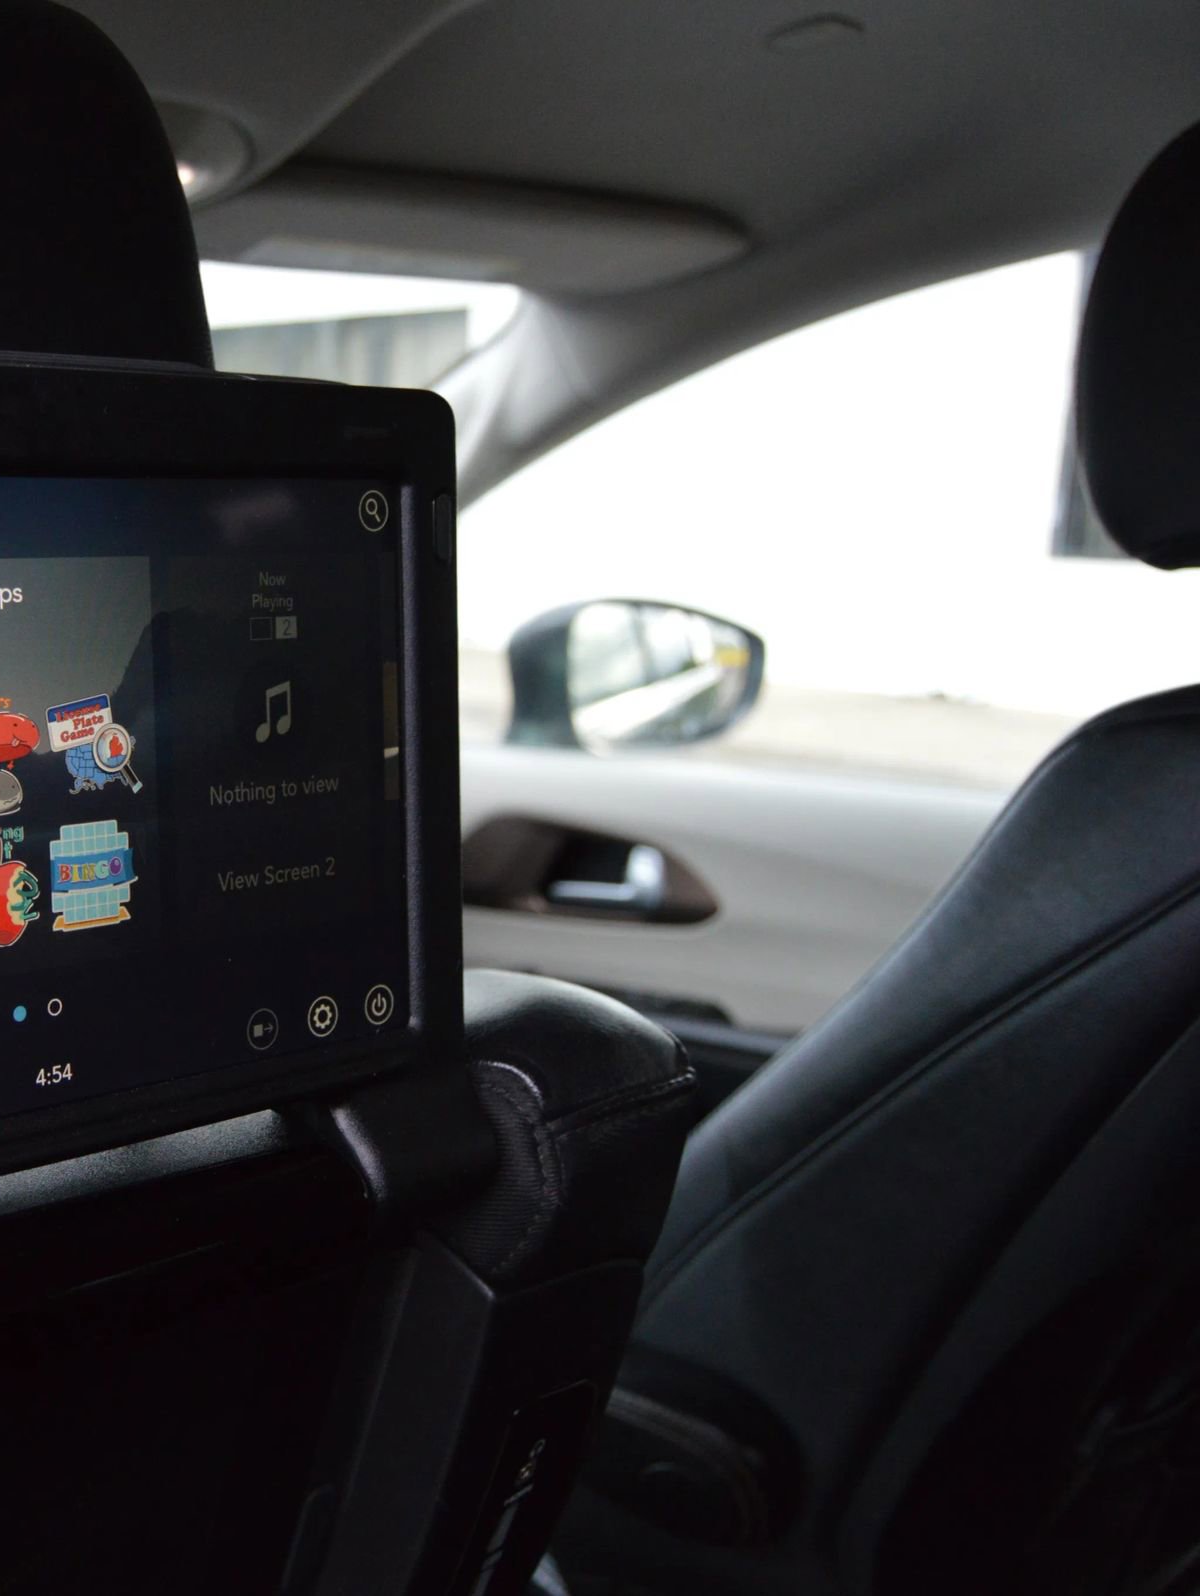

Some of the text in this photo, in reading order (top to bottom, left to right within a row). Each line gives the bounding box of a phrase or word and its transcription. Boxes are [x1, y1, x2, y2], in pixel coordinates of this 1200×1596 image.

[259, 571, 287, 586] Now
[251, 592, 294, 612] Playing
[72, 714, 105, 730] Plate
[60, 727, 95, 743] Game
[209, 775, 339, 806] Nothing to view
[57, 855, 122, 884] BINGO
[217, 856, 336, 892] View Screen 2
[35, 1062, 73, 1086] 4:54
